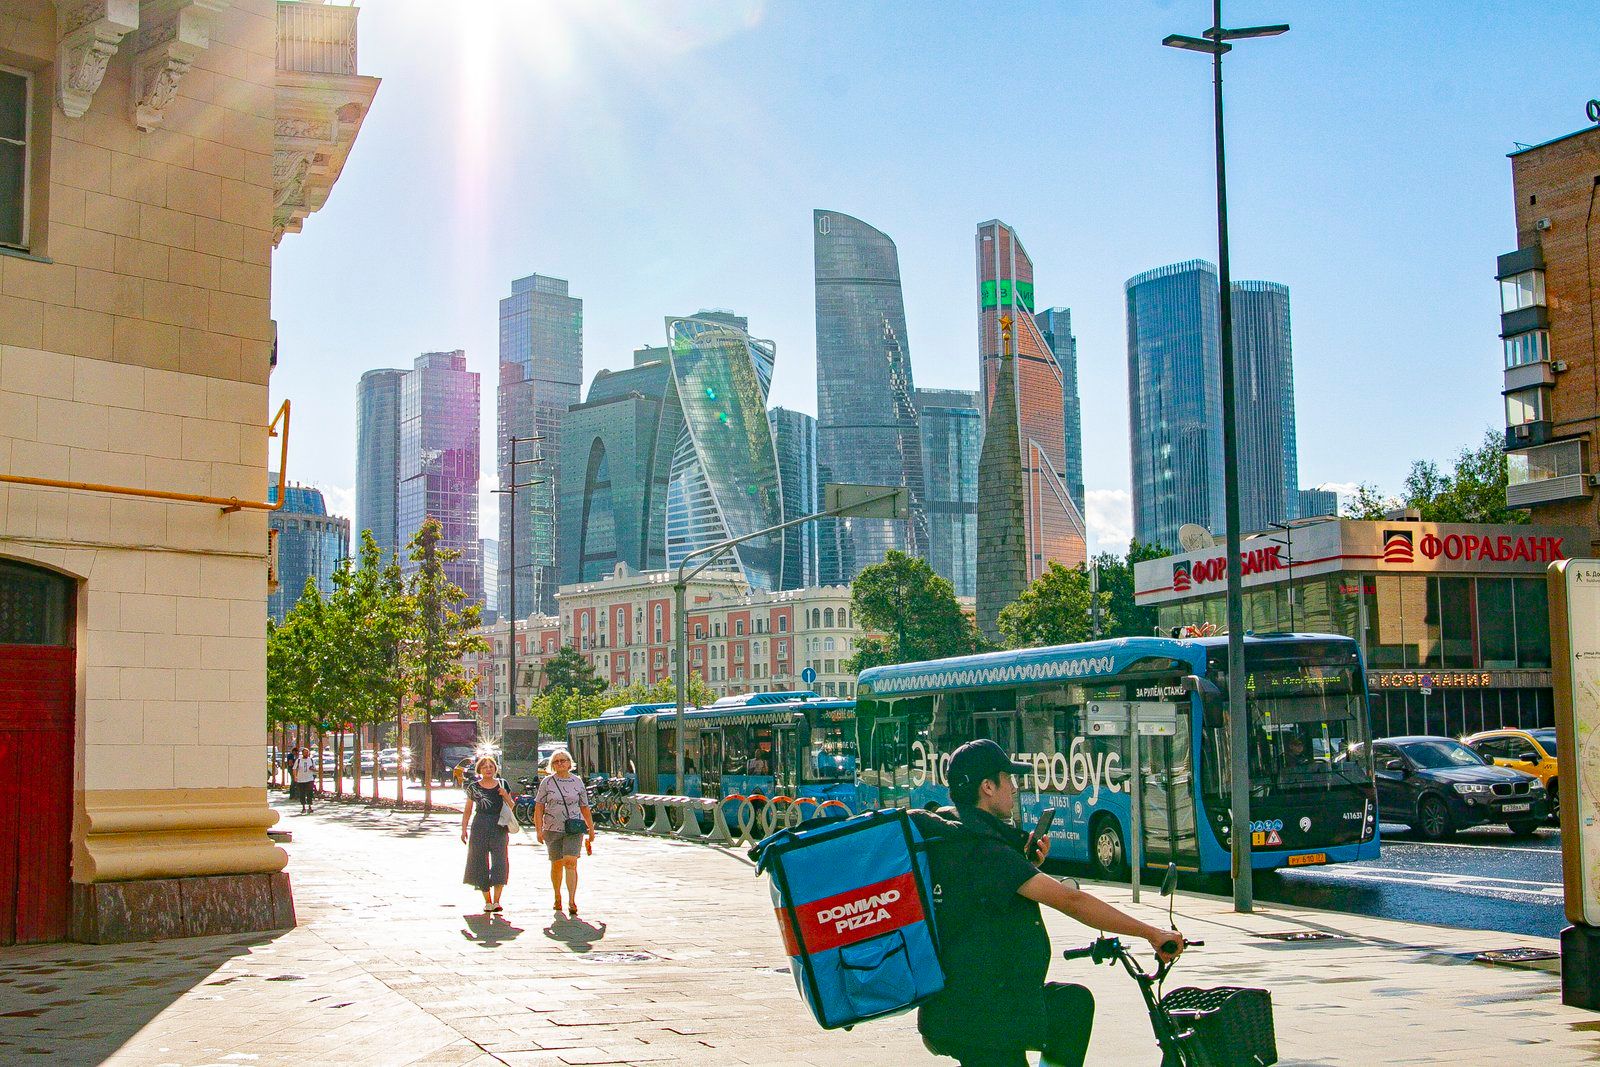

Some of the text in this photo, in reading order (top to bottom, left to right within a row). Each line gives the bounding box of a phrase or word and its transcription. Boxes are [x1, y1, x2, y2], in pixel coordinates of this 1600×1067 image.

[1420, 533, 1566, 563] ФОРАБАНК
[1192, 545, 1282, 584] ФОРБАНК
[1380, 673, 1491, 688] КОФЕМАНИЯ
[1049, 796, 1070, 808] 411631
[1343, 812, 1363, 820] 411631
[835, 907, 892, 934] PIZZA
